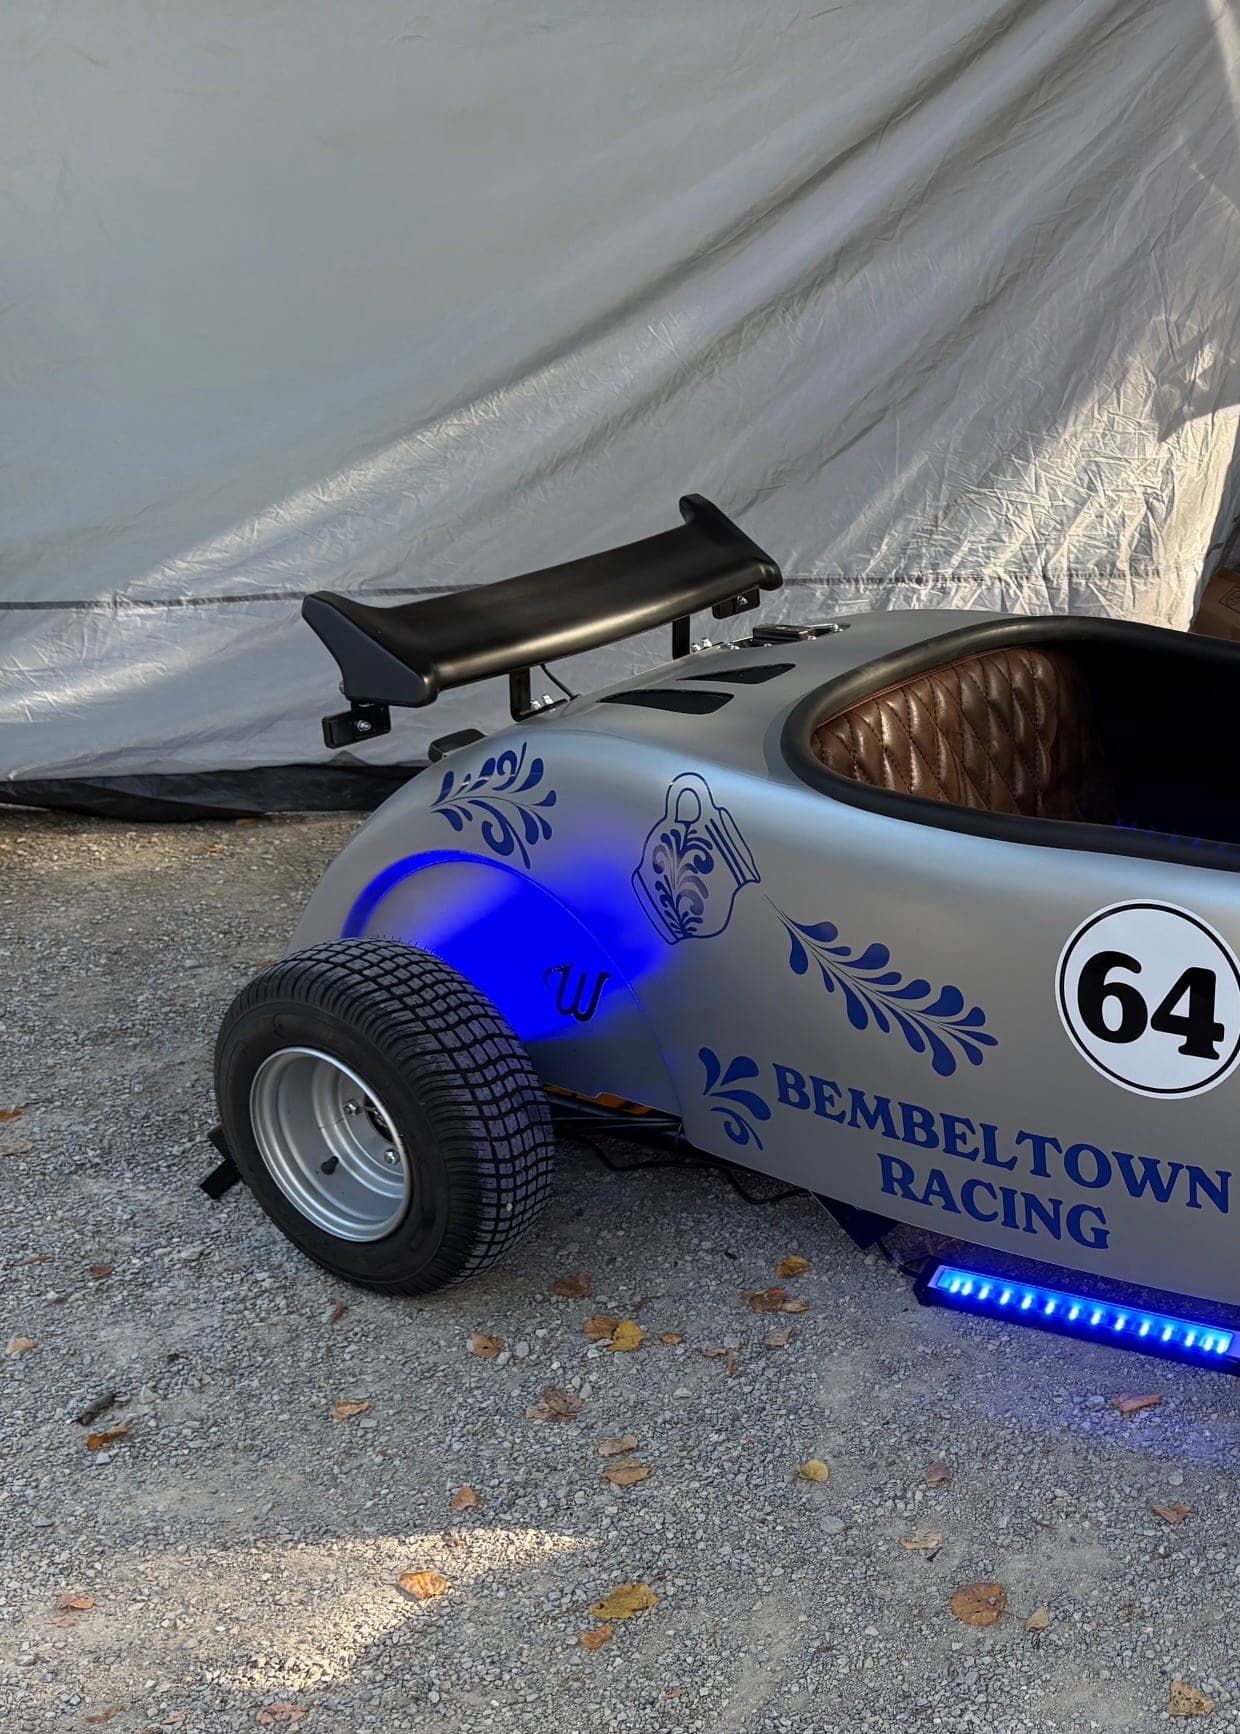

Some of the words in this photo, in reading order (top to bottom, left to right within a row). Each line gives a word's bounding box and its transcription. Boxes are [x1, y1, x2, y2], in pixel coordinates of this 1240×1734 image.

[1078, 951, 1225, 1060] 64
[772, 1063, 1232, 1213] BEMBELTOWN
[877, 1153, 1110, 1250] RACING
